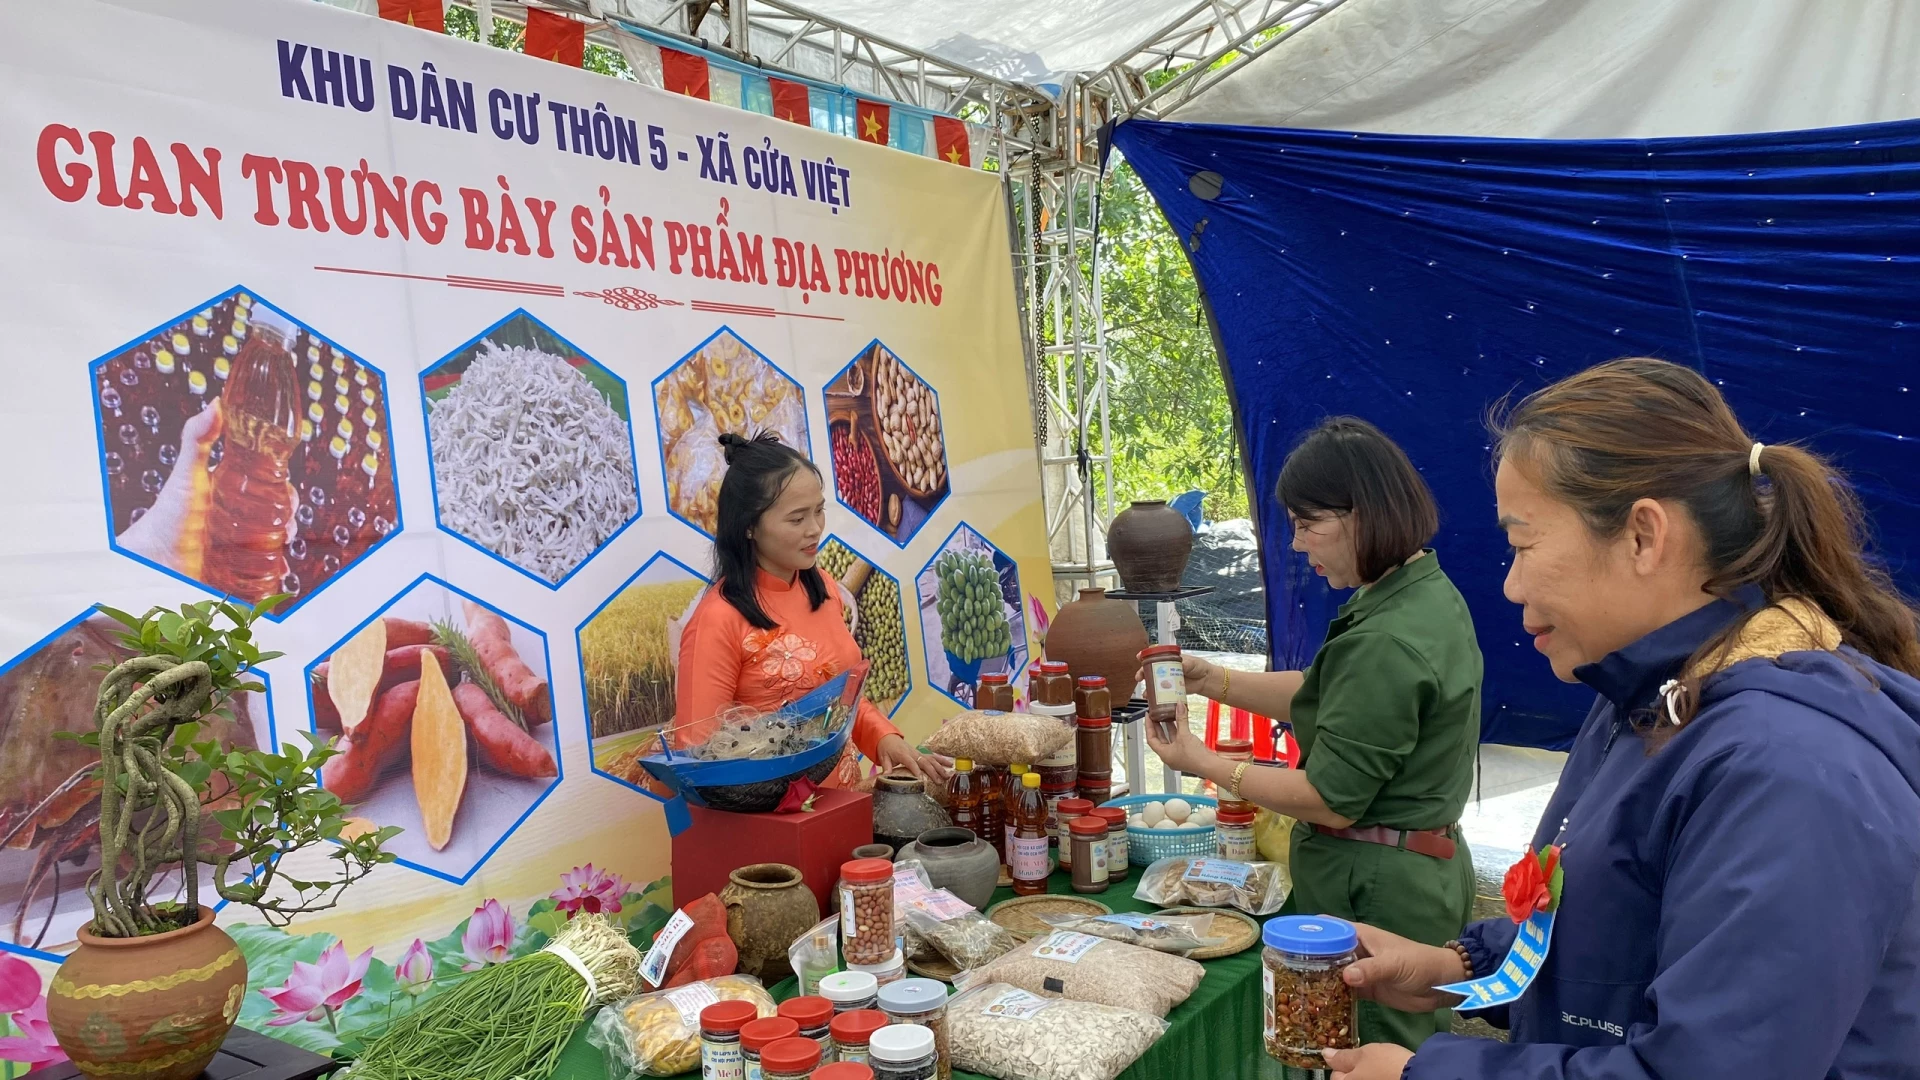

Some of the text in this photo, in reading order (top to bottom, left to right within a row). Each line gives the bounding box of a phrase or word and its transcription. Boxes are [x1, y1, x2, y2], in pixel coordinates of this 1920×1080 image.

[37, 123, 943, 307] GIAN TRƯNG BÀY SẢN PHẨM ĐỊA PHƯƠNG
[276, 39, 851, 215] KHU DÂN CƯ THÔN 5 - XÃ CỬA VIỆT
[1561, 1011, 1624, 1038] 3C.PLUSS
